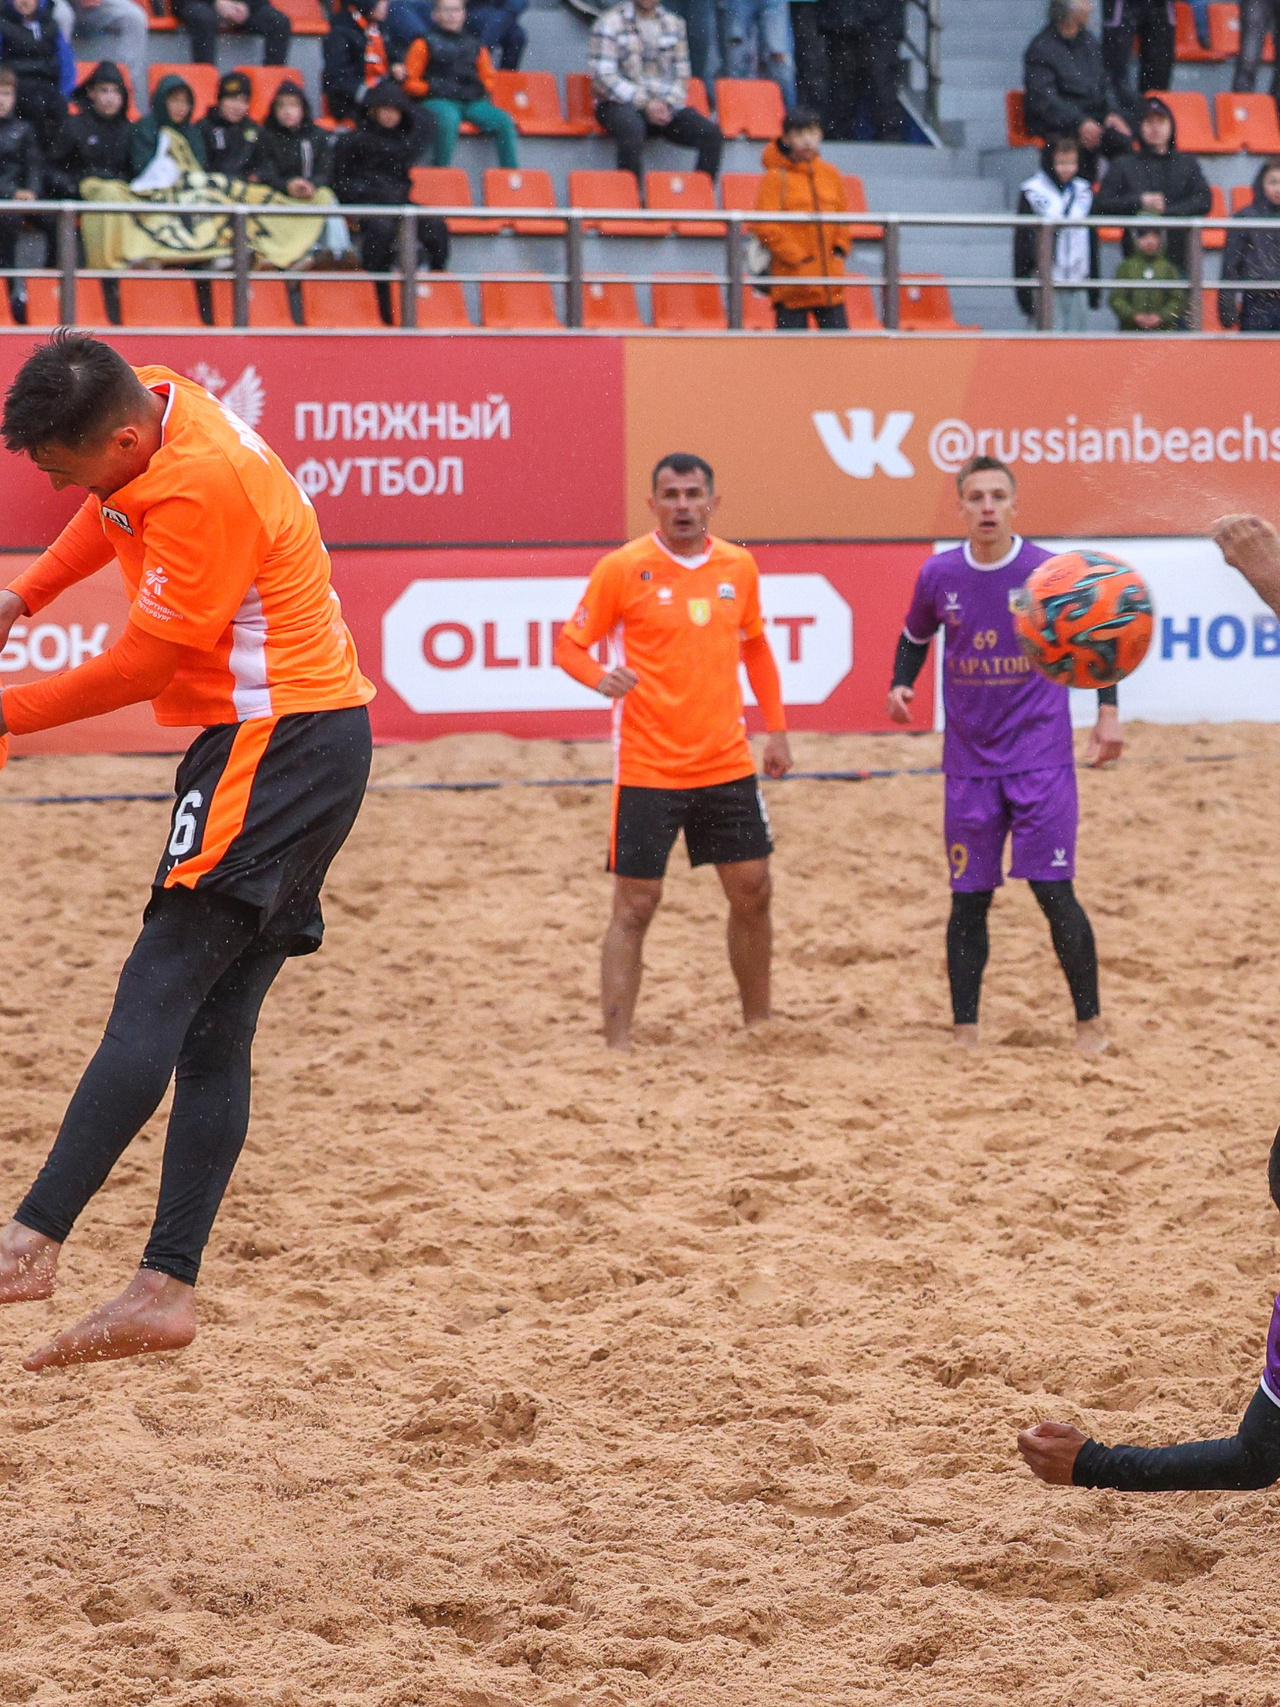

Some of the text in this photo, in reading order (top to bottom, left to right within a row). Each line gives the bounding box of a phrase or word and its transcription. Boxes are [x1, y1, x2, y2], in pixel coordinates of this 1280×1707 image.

[294, 393, 511, 441] ПЛЯЖНЫЙ
[811, 408, 916, 479] VK
[294, 455, 464, 499] ФУТБОЛ
[421, 616, 816, 670] OLIT
[973, 629, 998, 650] 69
[168, 789, 204, 857] 6
[949, 843, 969, 879] 9
